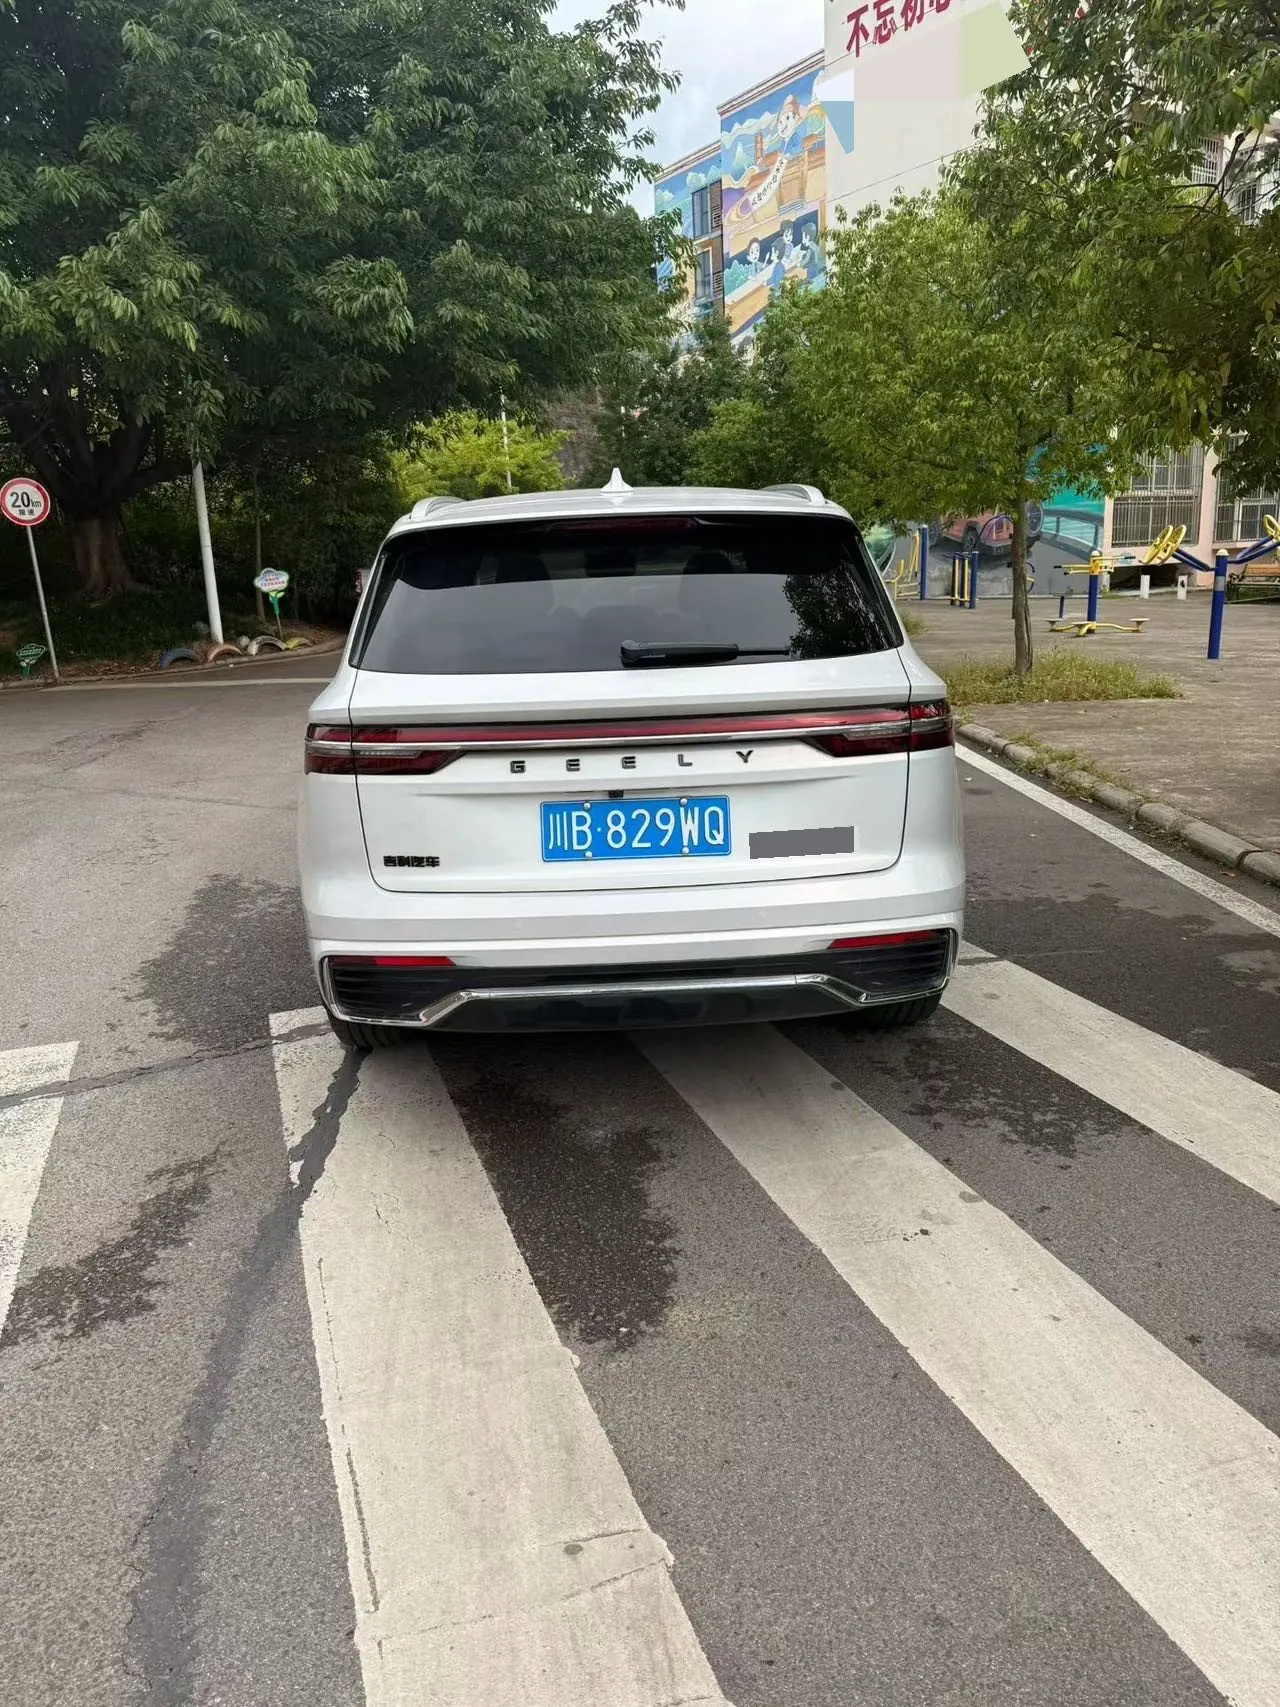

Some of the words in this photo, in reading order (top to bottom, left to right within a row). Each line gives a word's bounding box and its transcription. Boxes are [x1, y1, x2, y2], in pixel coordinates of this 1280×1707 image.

[509, 749, 754, 773] GEELY
[548, 806, 725, 851] 川B·829WQ
[383, 855, 440, 868] 吉利汽车
